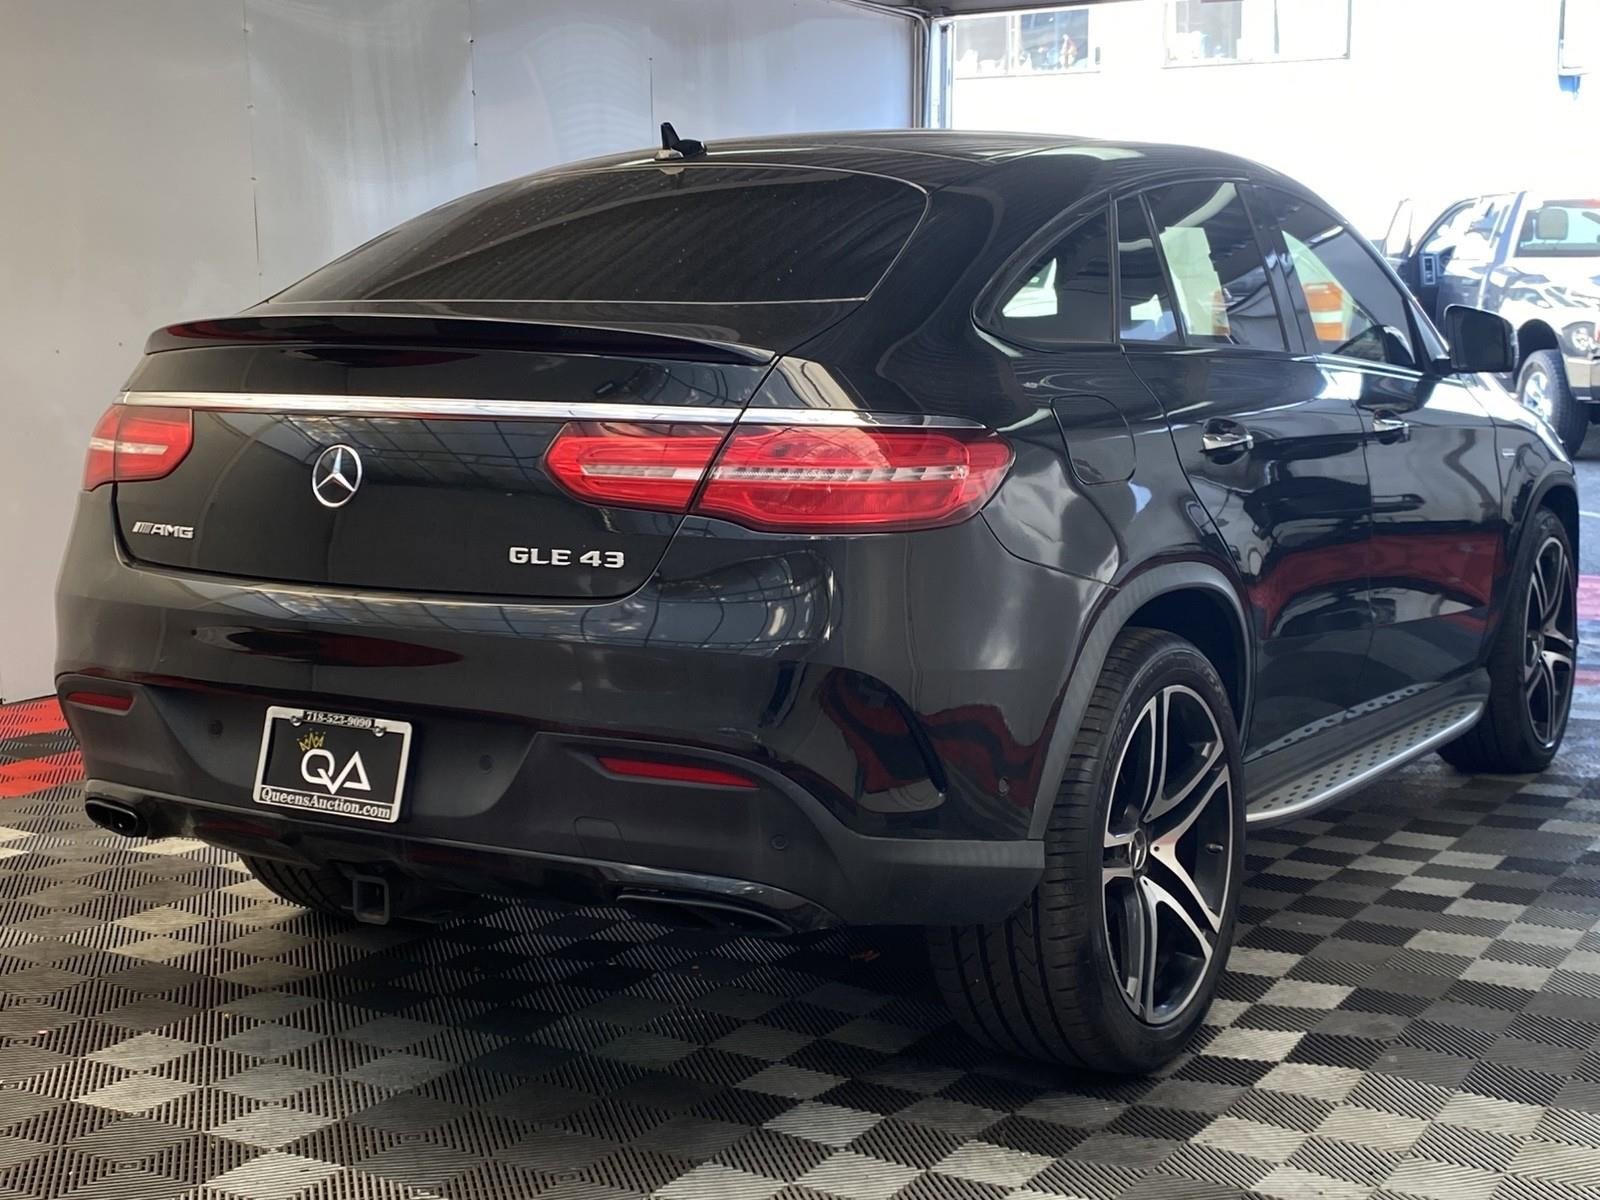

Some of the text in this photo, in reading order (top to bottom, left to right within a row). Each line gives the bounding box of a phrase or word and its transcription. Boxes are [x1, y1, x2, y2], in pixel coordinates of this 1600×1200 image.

[150, 523, 194, 539] AMG
[509, 546, 625, 569] GLE 43
[306, 711, 372, 729] 718-523-9090
[301, 748, 372, 795] QA
[261, 787, 391, 819] QueensAuction.com
